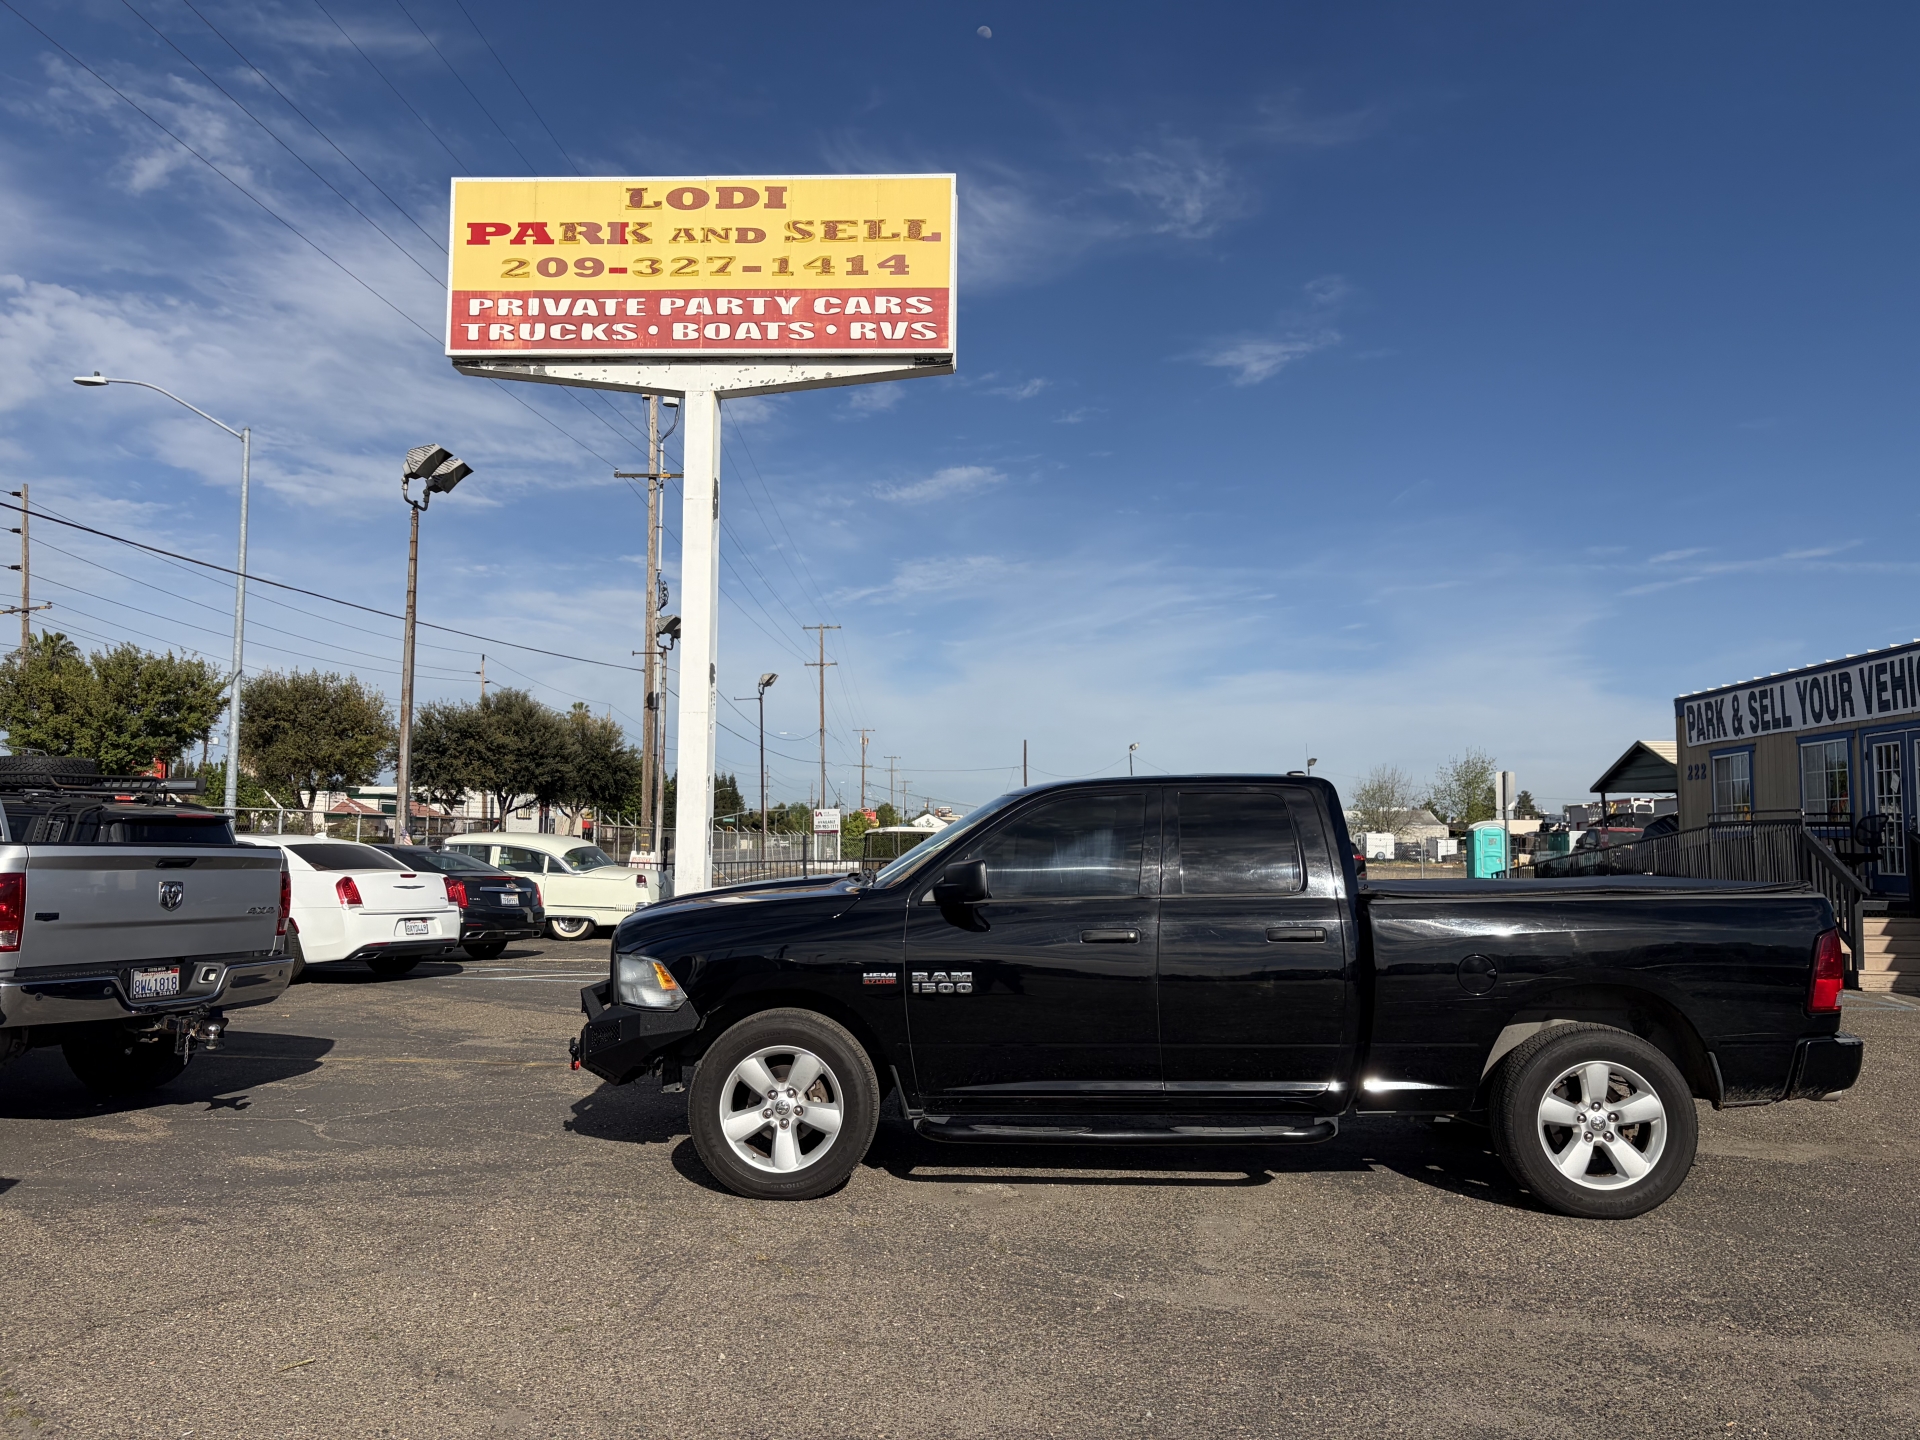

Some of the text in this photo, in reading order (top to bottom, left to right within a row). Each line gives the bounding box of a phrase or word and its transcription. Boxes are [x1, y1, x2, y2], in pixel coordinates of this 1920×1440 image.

[625, 186, 787, 210] LODI
[467, 218, 942, 245] PARK AND SELL
[501, 254, 909, 278] 209-327-1414
[469, 296, 935, 316] PRIVATE PARTY CARS
[460, 321, 938, 341] TRUCKS BOATS RVS
[1686, 655, 1920, 743] PARK & SELL YOUR VEHI
[1687, 763, 1707, 780] 222
[135, 976, 177, 994] 8W41818
[912, 972, 972, 982] RAM
[912, 983, 973, 993] 1500
